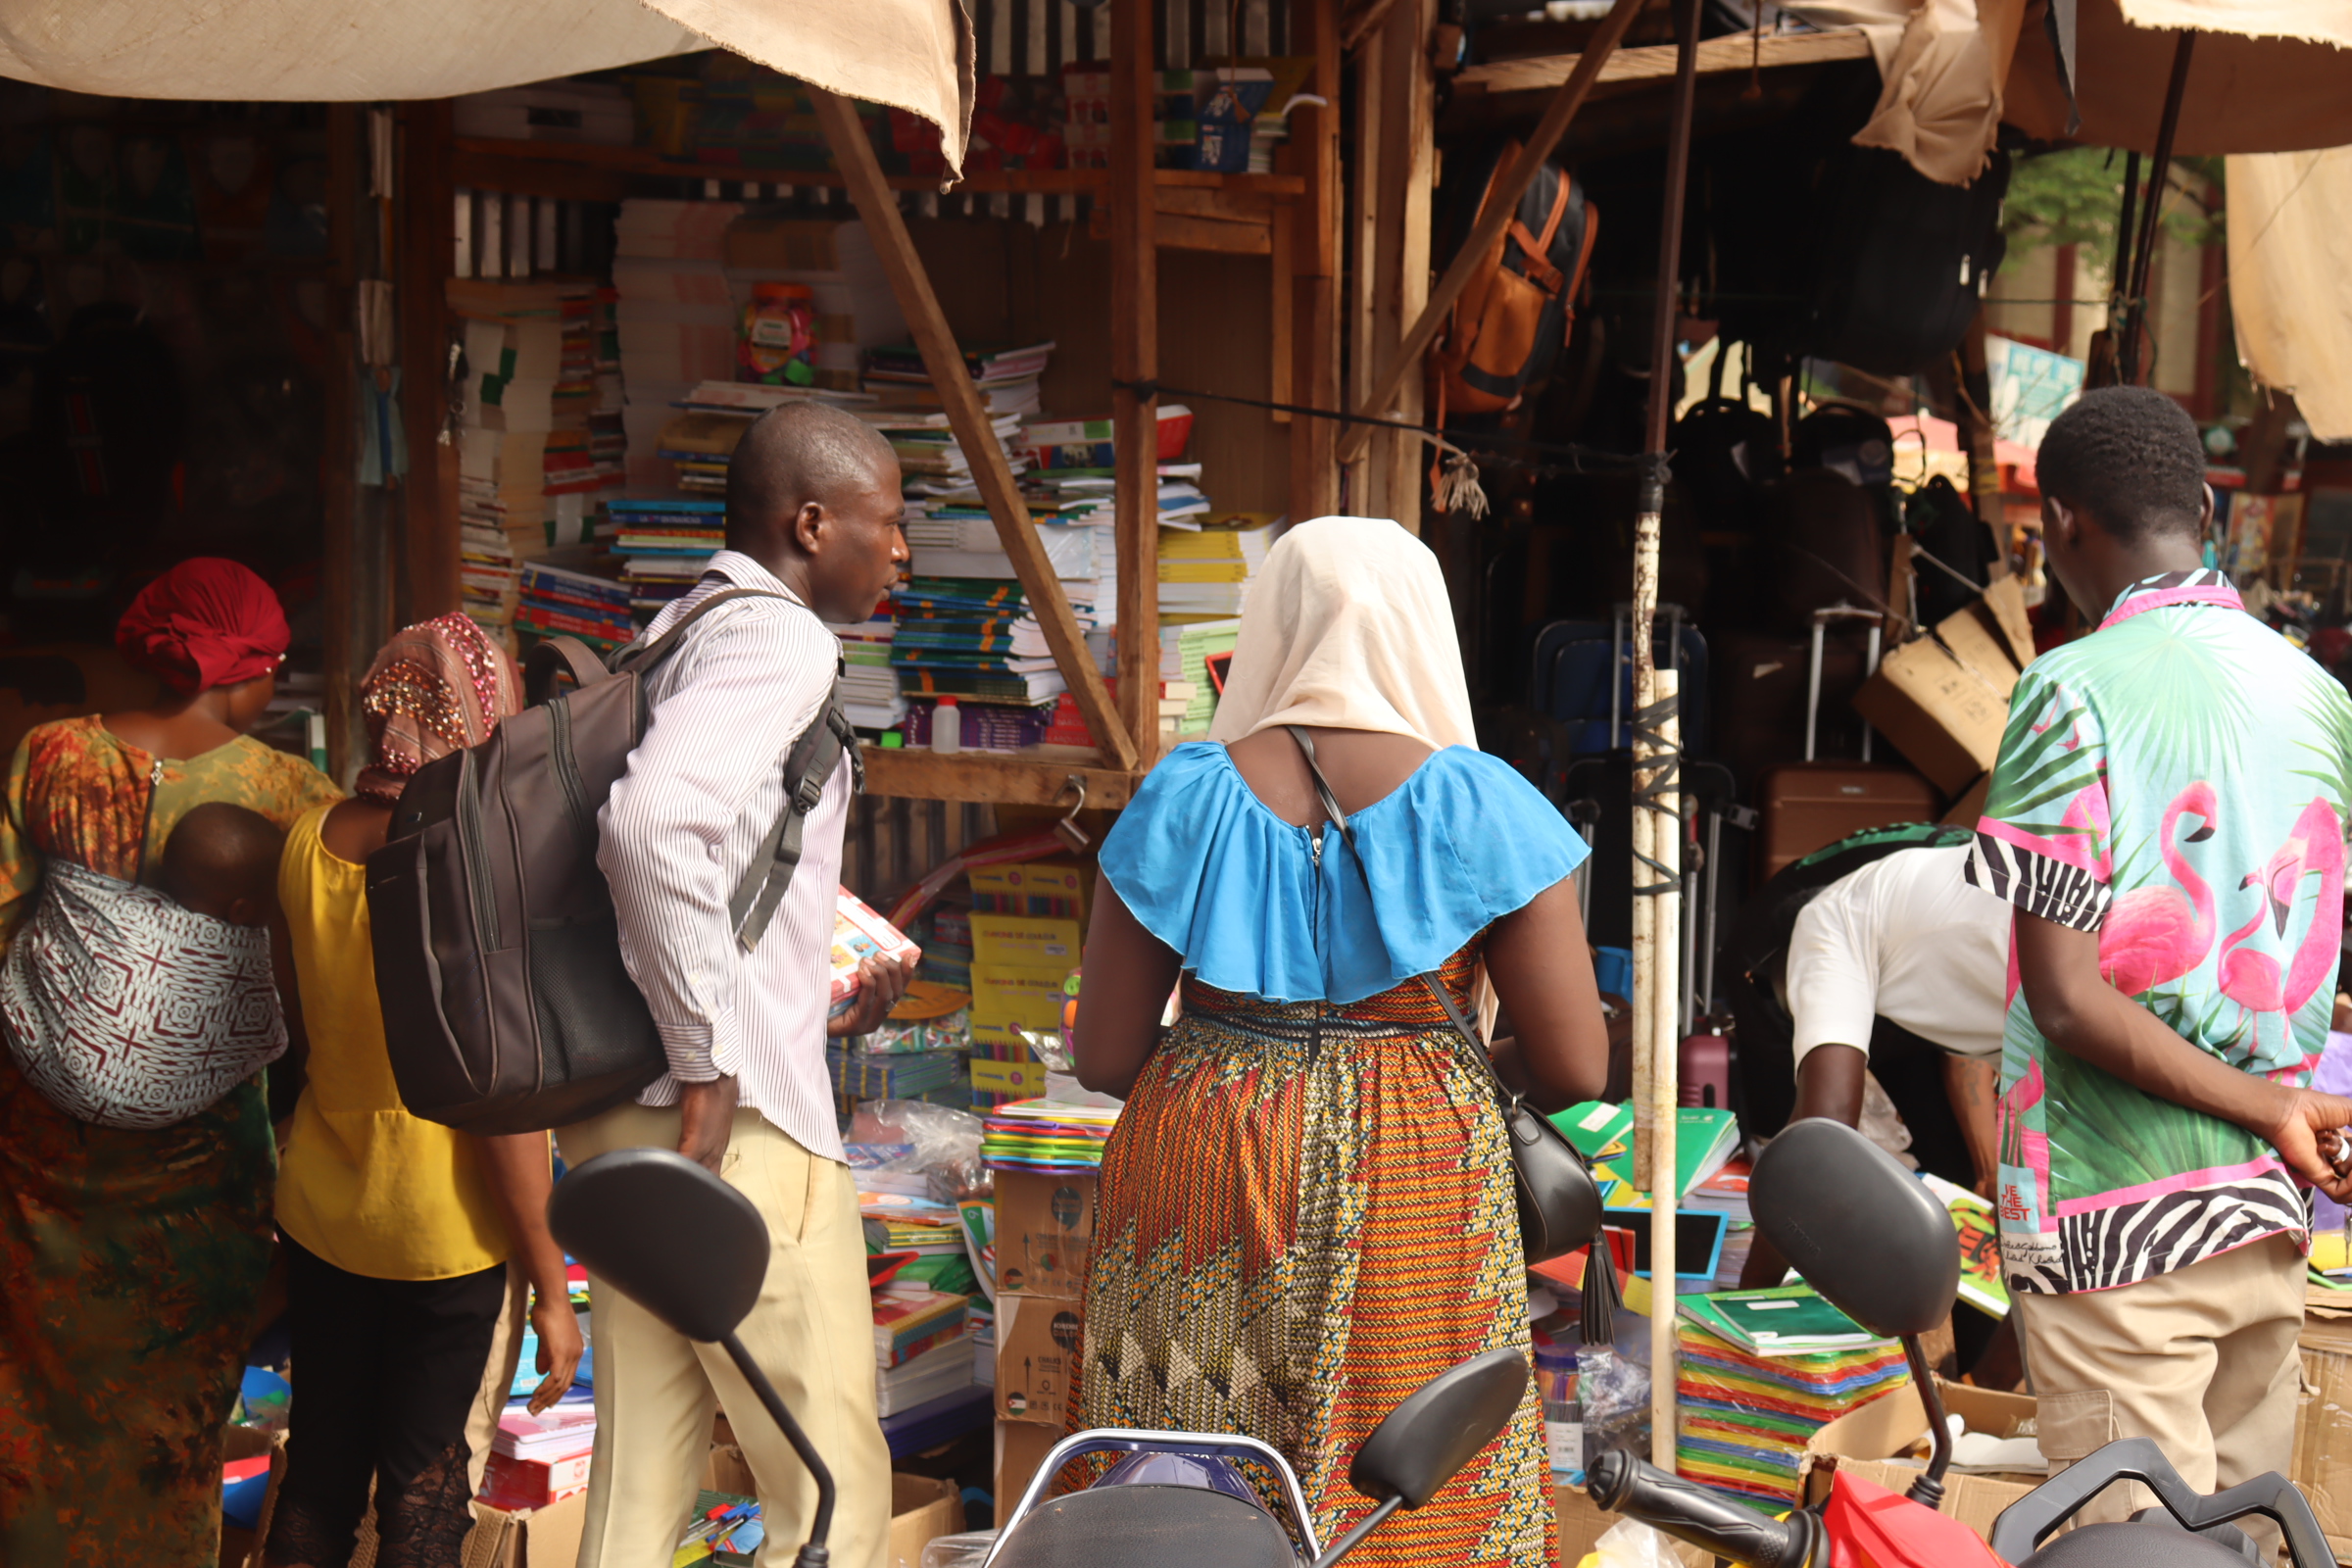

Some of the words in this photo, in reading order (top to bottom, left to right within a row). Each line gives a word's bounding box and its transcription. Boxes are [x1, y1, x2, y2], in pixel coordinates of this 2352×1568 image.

[2001, 1194, 2024, 1208] THE
[1999, 1205, 2033, 1221] BEST
[1038, 1356, 1061, 1365] CHALKS
